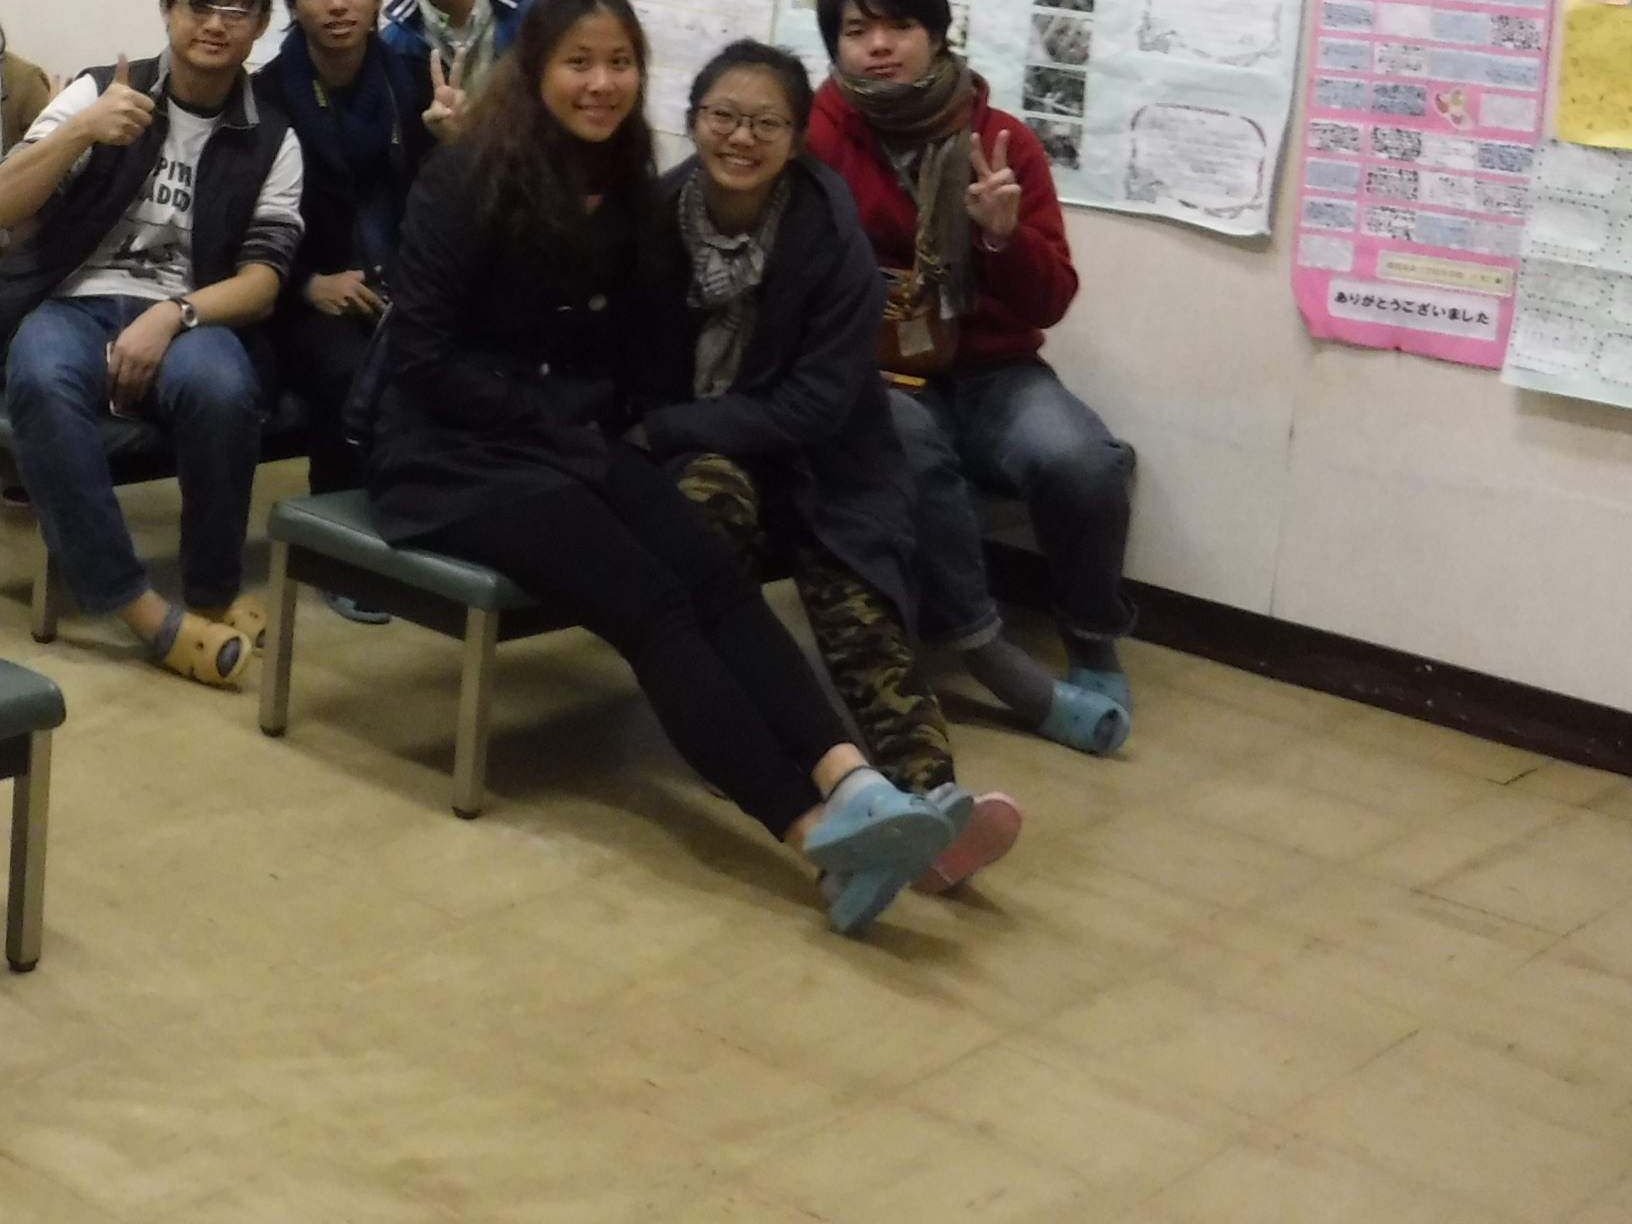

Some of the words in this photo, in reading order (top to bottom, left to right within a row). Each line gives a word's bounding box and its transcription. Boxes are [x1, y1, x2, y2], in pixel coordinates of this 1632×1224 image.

[1334, 290, 1491, 326] ありがとうございました
